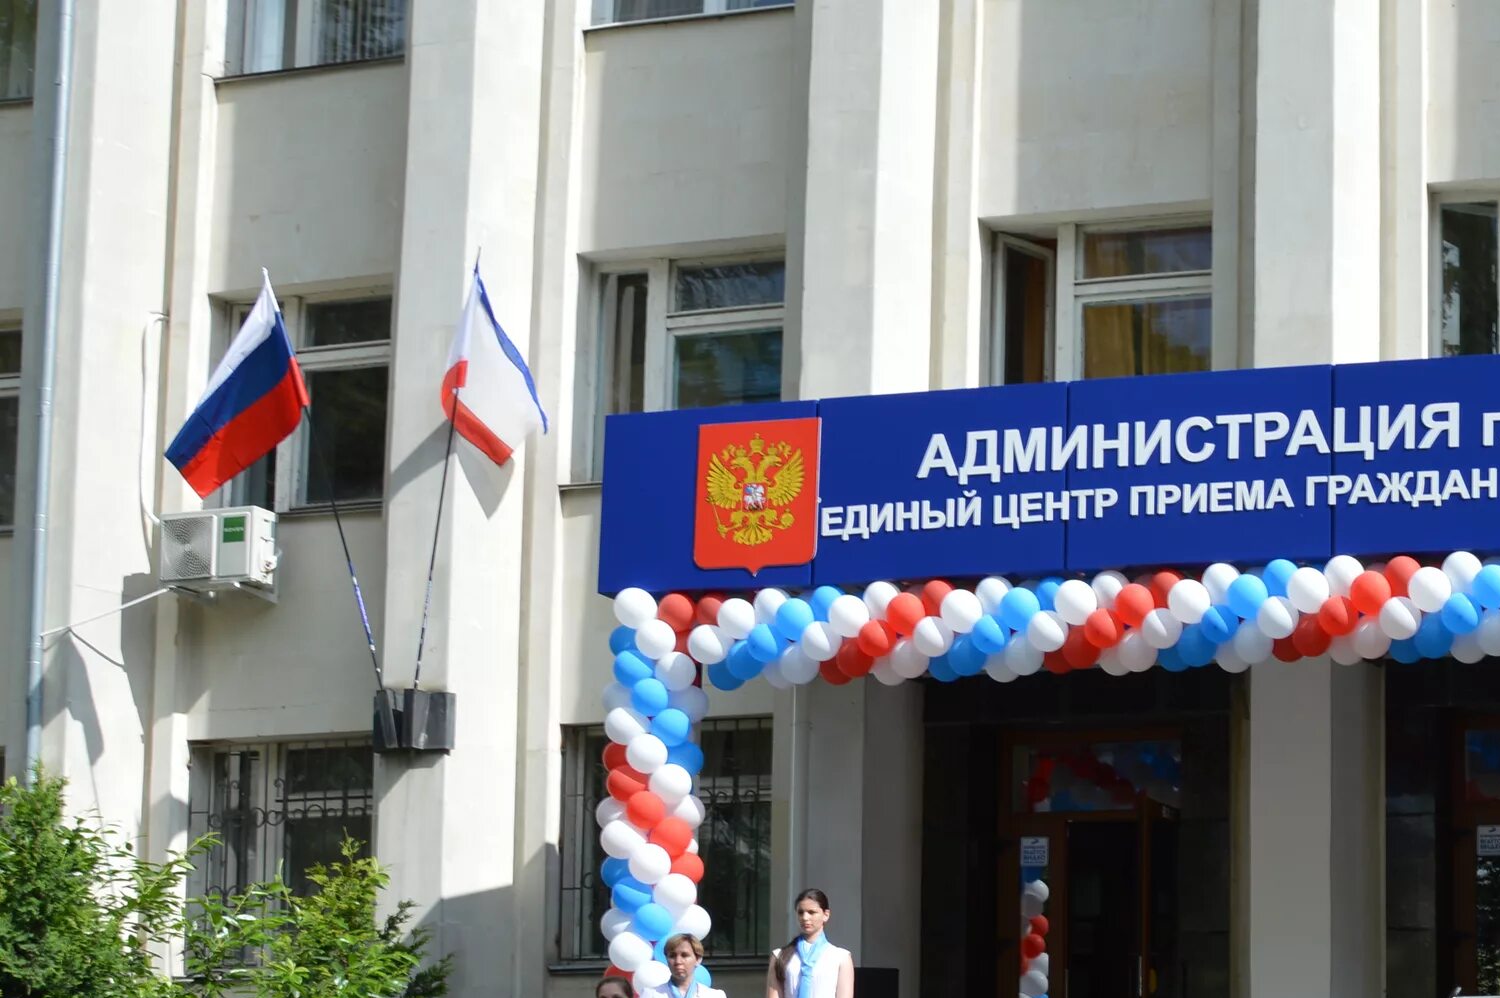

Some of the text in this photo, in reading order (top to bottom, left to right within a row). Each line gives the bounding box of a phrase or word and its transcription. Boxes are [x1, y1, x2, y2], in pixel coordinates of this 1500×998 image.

[917, 402, 1460, 484] АДМИНИСТРАЦИЯ
[821, 489, 982, 541] ЕДИНЫЙ
[994, 487, 1119, 528] ЦЕНТР
[1130, 479, 1295, 516] ПРИЕМА
[1306, 468, 1498, 510] ГРАЖДАН
